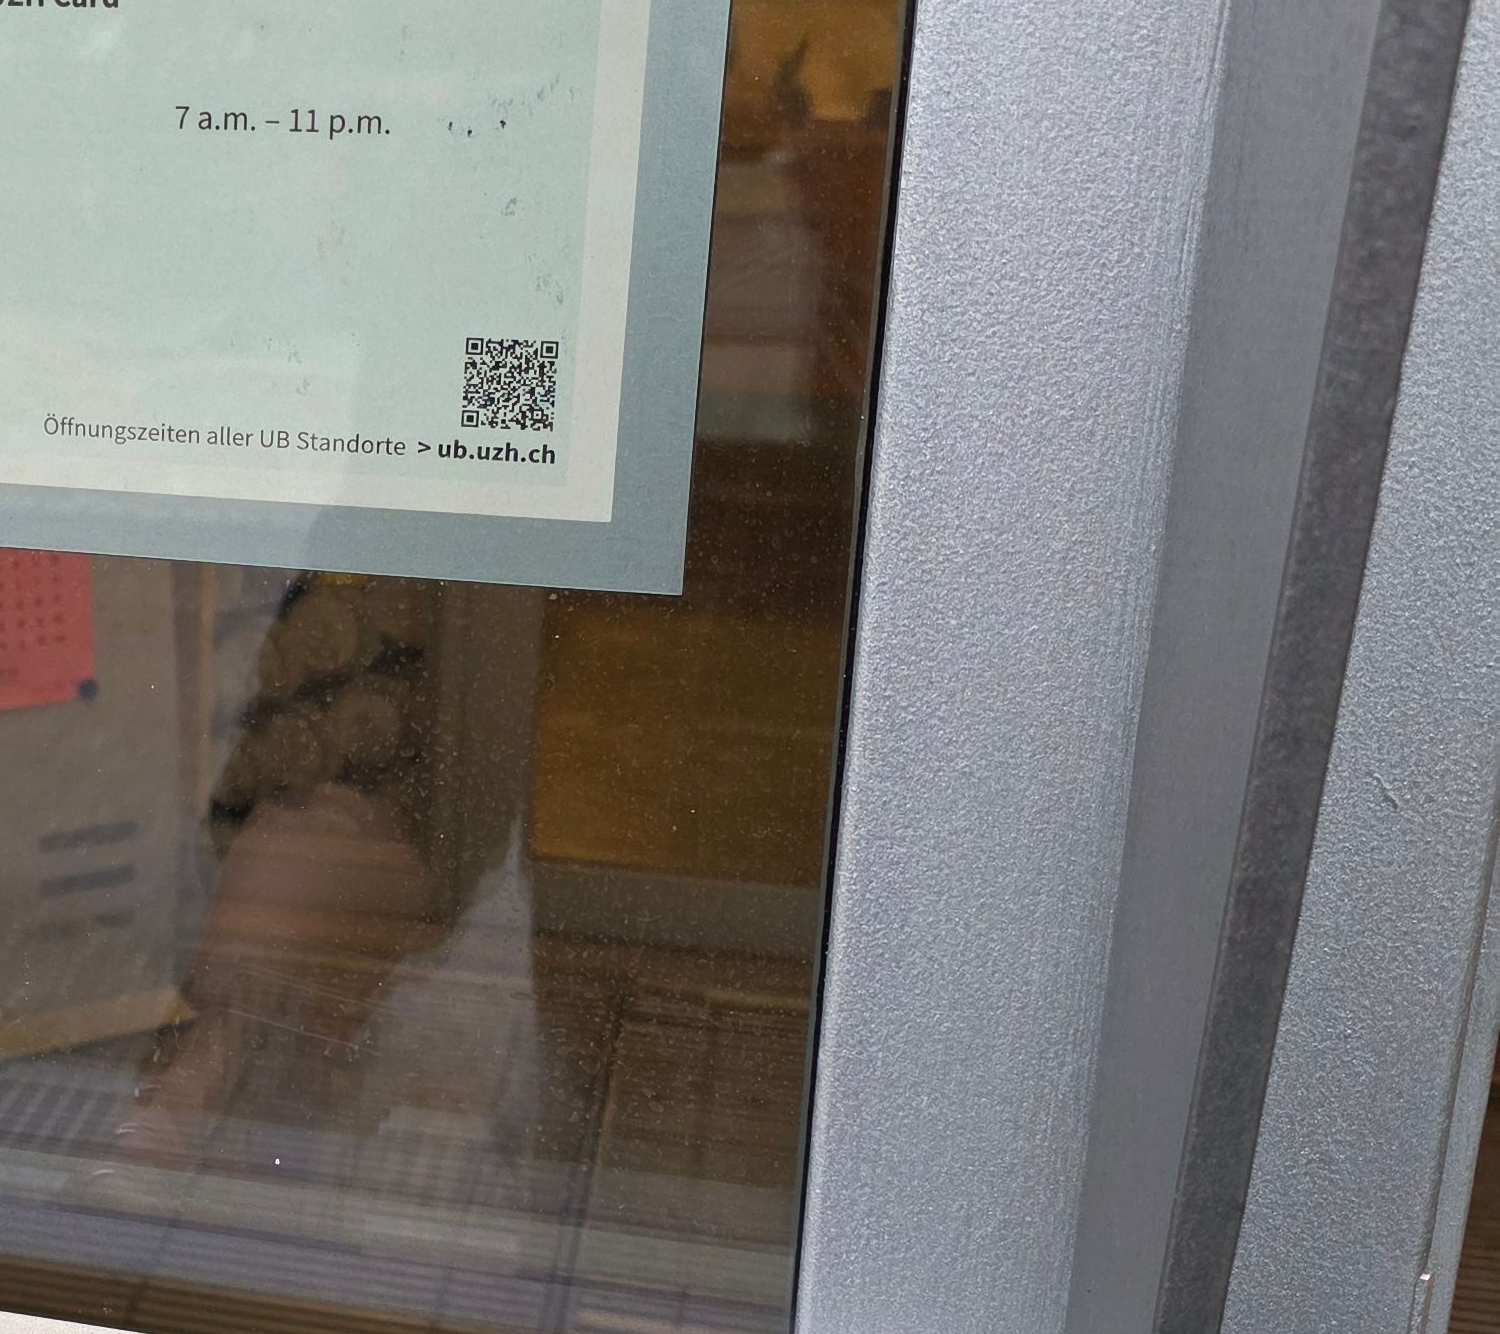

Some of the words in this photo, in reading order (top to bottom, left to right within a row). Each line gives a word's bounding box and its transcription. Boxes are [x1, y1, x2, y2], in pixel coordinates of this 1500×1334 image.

[175, 105, 190, 130] 7
[197, 111, 256, 132] a.m.
[289, 108, 320, 133] 11
[329, 114, 390, 141] p.m.
[43, 412, 200, 445] Öffnungszeiten
[206, 425, 254, 447] aller
[260, 429, 290, 449] UB
[296, 431, 406, 456] Standorte
[437, 439, 556, 465] ub.uzh.ch
